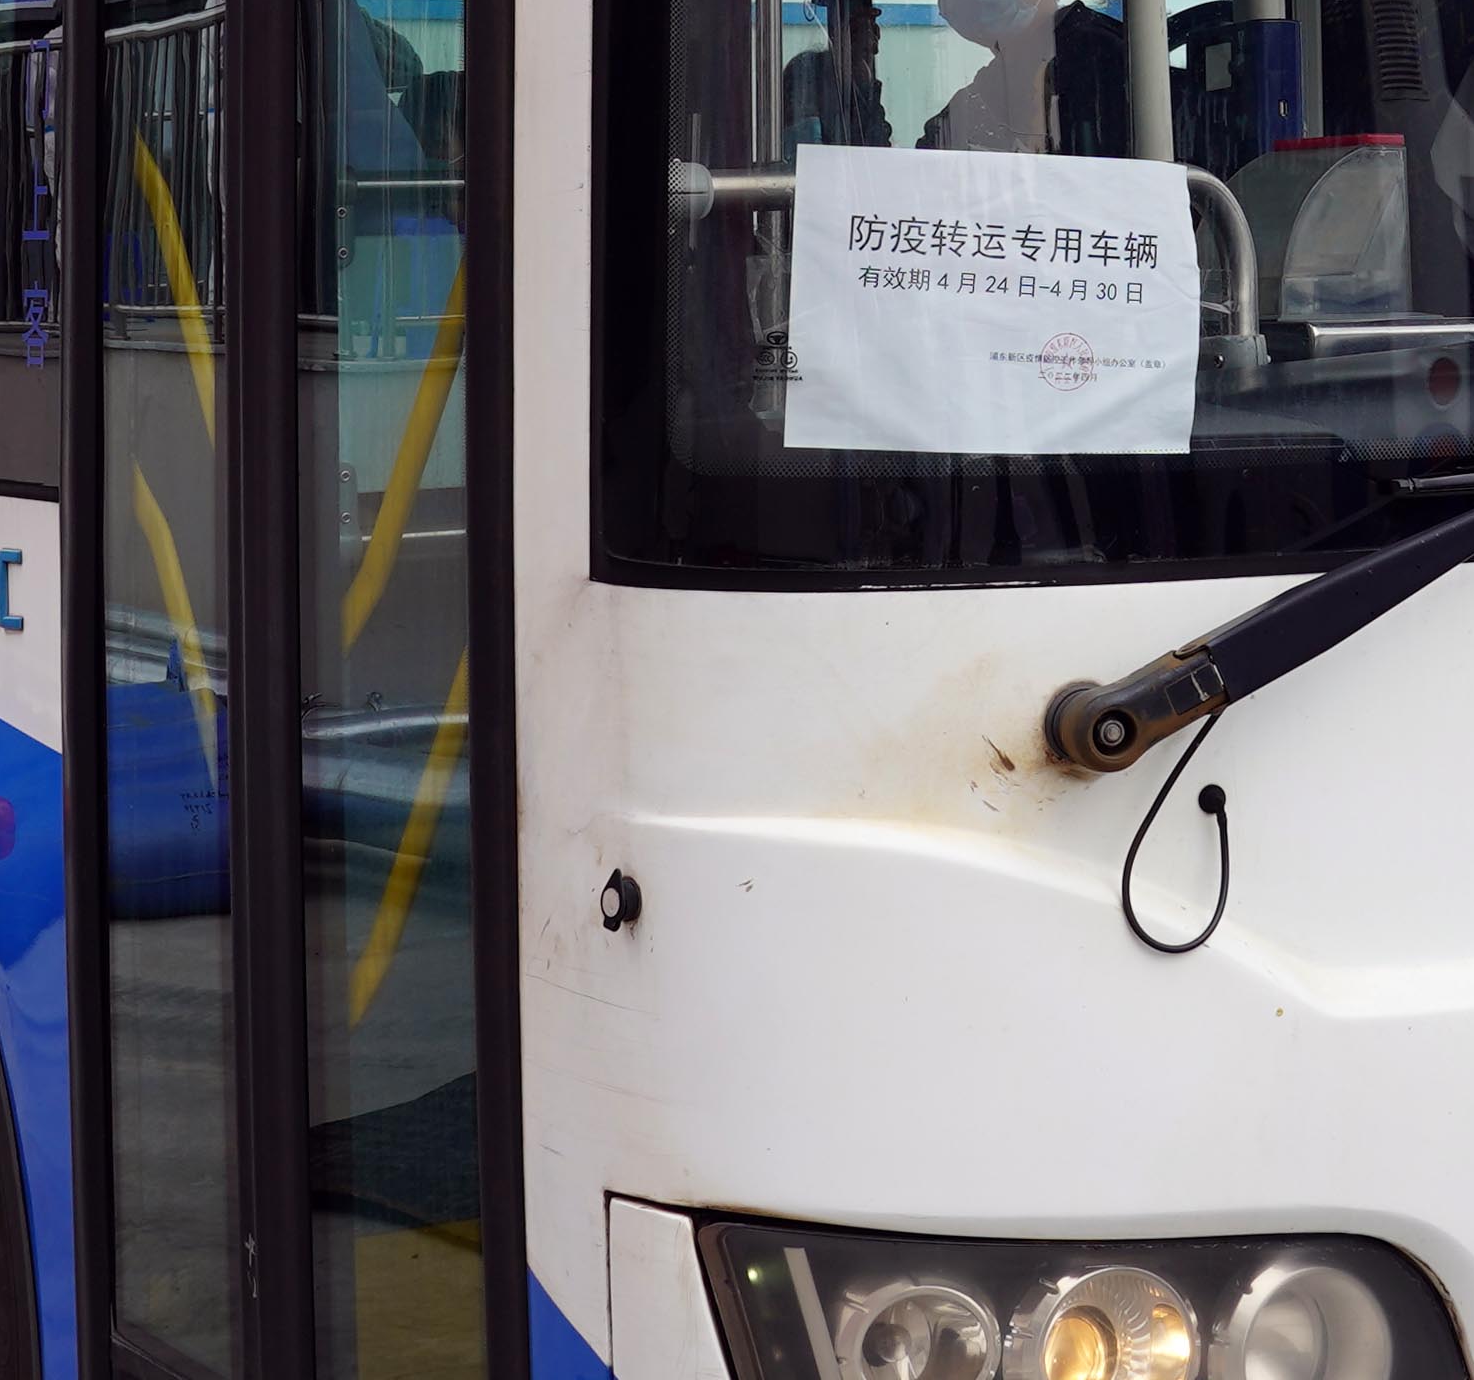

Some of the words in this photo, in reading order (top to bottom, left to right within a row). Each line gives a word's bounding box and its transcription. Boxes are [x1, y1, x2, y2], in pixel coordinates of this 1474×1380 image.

[849, 214, 1158, 269] 防疫转运专用车辆
